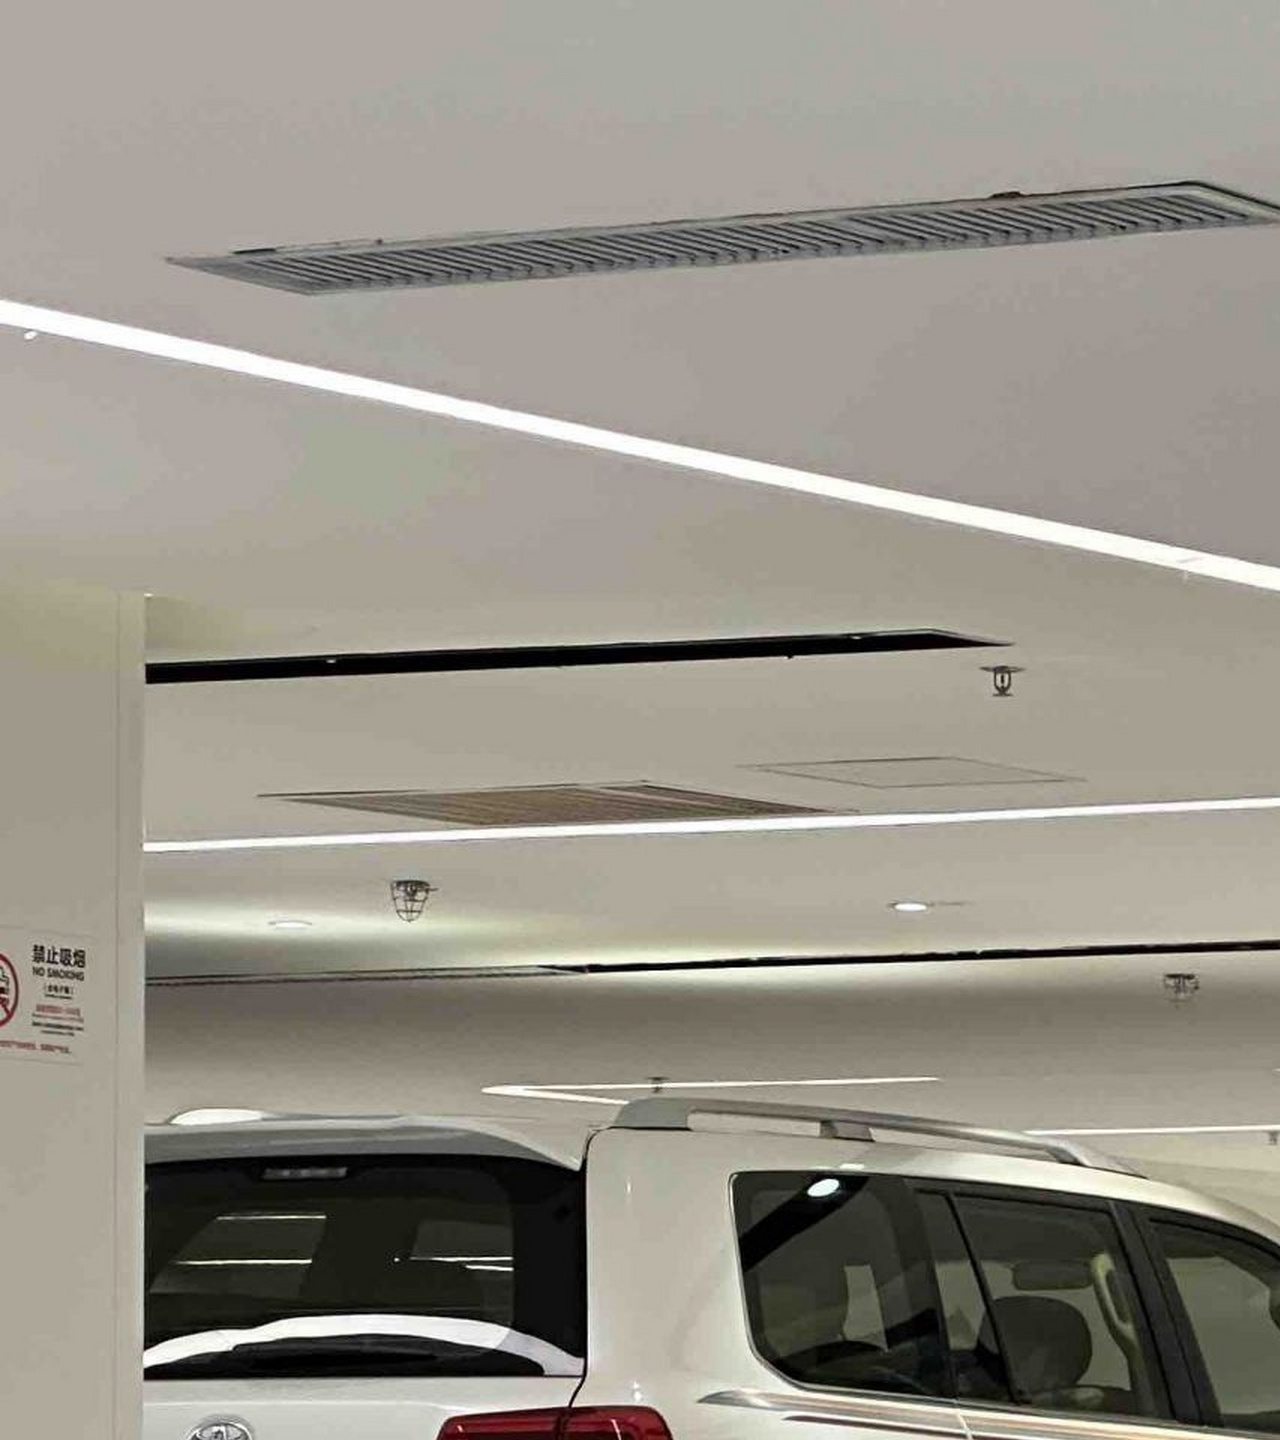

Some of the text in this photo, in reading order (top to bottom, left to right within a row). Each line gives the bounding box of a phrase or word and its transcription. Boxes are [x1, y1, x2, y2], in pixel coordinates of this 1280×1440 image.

[32, 945, 86, 968] 禁止吸烟
[32, 966, 85, 981] NO SMOKING
